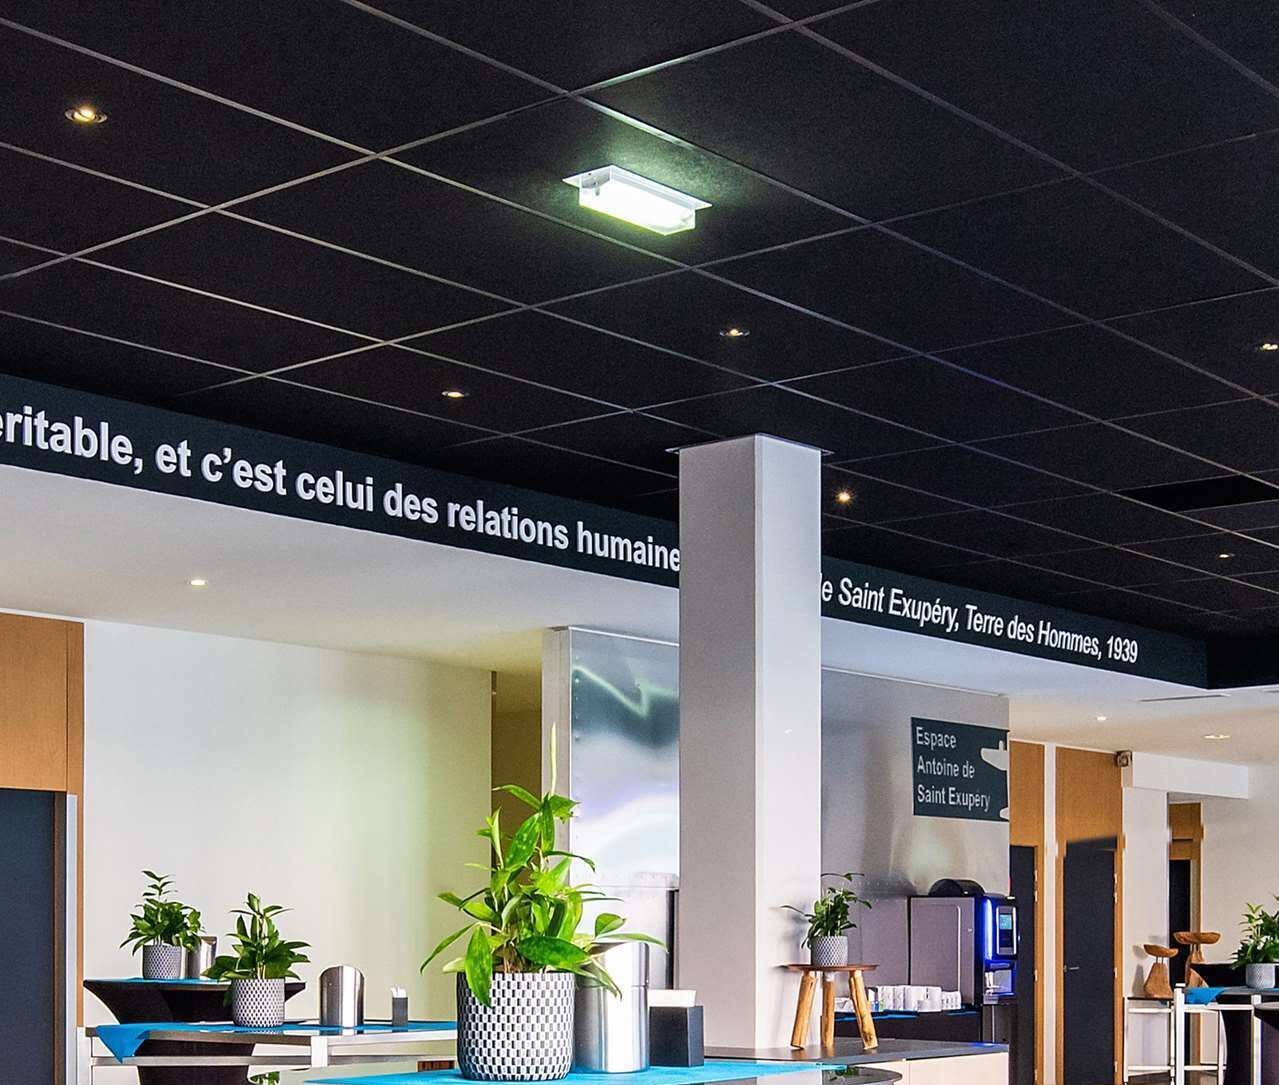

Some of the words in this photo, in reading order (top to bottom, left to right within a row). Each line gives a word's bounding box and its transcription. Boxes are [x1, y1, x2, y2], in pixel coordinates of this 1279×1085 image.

[155, 439, 192, 477] et
[201, 447, 287, 496] c’est
[295, 470, 374, 512] celui
[383, 482, 439, 524] des
[447, 499, 569, 550] relations
[838, 577, 886, 613] Saint
[888, 587, 960, 633] Exupéry,
[965, 603, 1004, 637] Terre
[1006, 614, 1035, 643] des
[1037, 619, 1102, 660] Hommes,
[1106, 635, 1138, 664] 1939
[916, 726, 957, 751] Espace
[916, 755, 960, 777] Antoine
[962, 760, 975, 779] de
[917, 784, 946, 805] Saint
